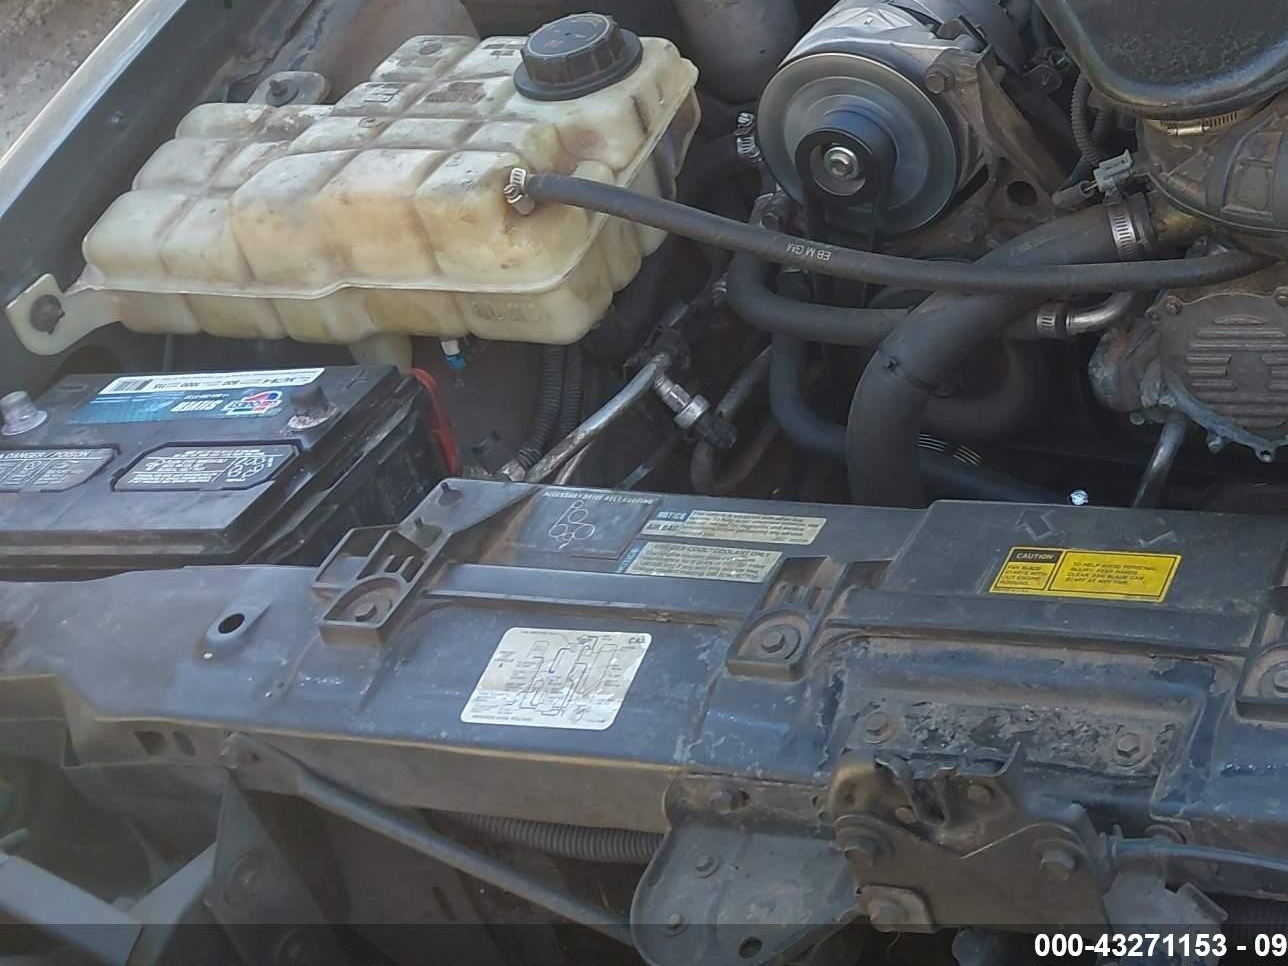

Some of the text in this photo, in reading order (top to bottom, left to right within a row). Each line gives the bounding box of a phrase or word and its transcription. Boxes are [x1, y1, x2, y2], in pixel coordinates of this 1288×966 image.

[171, 399, 224, 412] SILVER
[5, 451, 43, 459] DANGER
[55, 450, 91, 459] POISON
[656, 511, 688, 520] NOTICE
[646, 522, 661, 531] AIR
[1016, 553, 1055, 561] CAUTION
